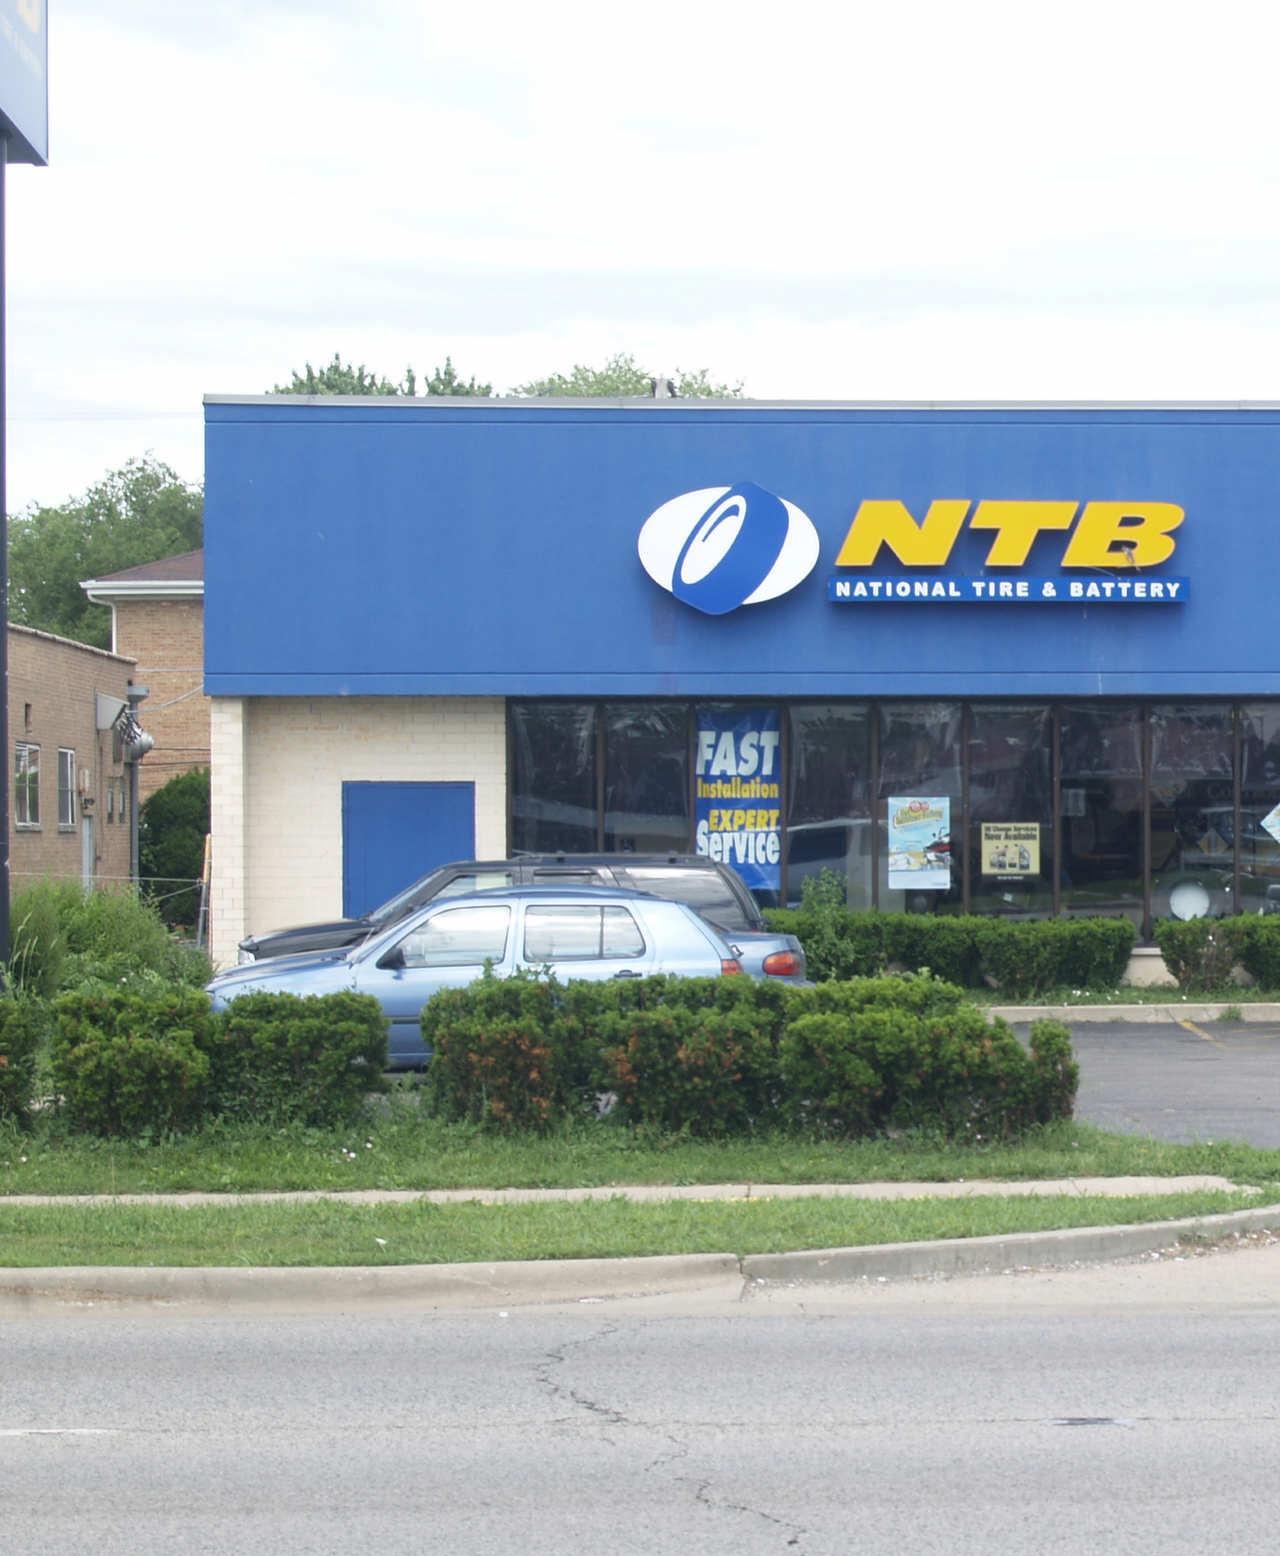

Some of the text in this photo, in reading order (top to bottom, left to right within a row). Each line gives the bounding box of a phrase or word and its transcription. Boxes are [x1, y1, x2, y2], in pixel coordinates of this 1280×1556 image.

[835, 499, 1186, 567] NTB
[835, 580, 1181, 598] NATIONAL TIRE & BATTERY
[696, 731, 780, 776] FAST
[697, 776, 779, 799] Installation
[709, 808, 780, 832] EXPERT
[696, 819, 780, 865] Service
